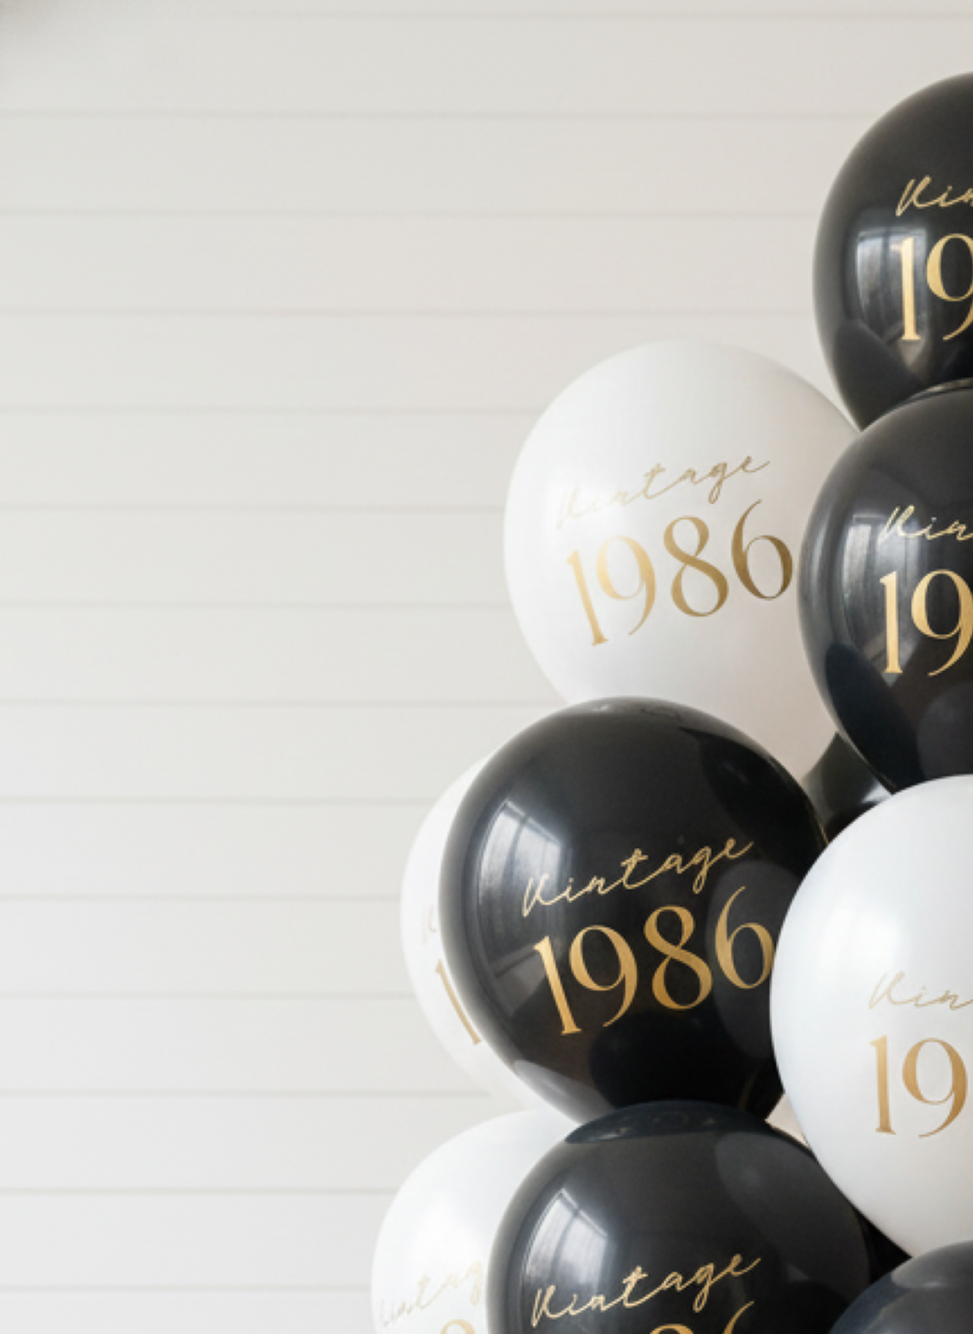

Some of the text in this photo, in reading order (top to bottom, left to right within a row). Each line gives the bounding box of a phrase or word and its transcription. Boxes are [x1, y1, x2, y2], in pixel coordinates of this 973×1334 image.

[566, 500, 793, 646] 1986
[522, 837, 754, 918] Vintage
[533, 886, 775, 1036] 1986
[532, 1253, 761, 1328] Vintage
